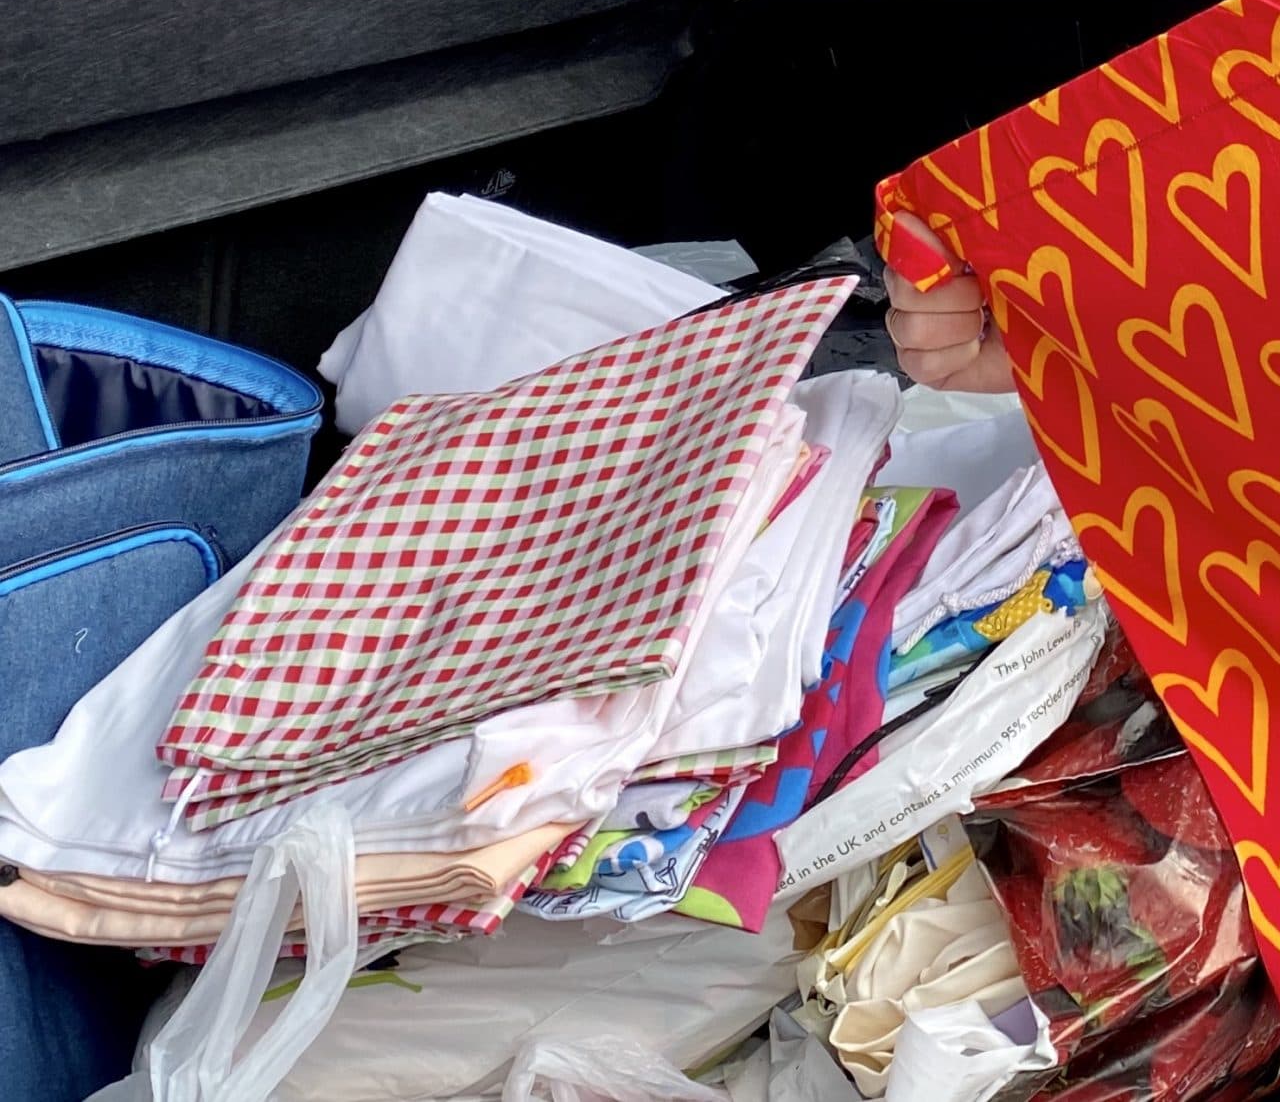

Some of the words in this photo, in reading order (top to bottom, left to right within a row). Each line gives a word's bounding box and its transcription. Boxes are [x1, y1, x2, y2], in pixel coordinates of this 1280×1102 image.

[994, 661, 1019, 677] The
[1021, 648, 1045, 671] John
[1046, 629, 1072, 653] Lewis
[796, 867, 811, 879] in
[813, 853, 836, 870] the
[836, 836, 861, 856] UK
[863, 821, 887, 842] and
[889, 789, 941, 826] contains
[943, 782, 952, 793] a
[951, 741, 1004, 786] minimum
[1001, 718, 1027, 743] 95%
[1027, 686, 1063, 724] recycled
